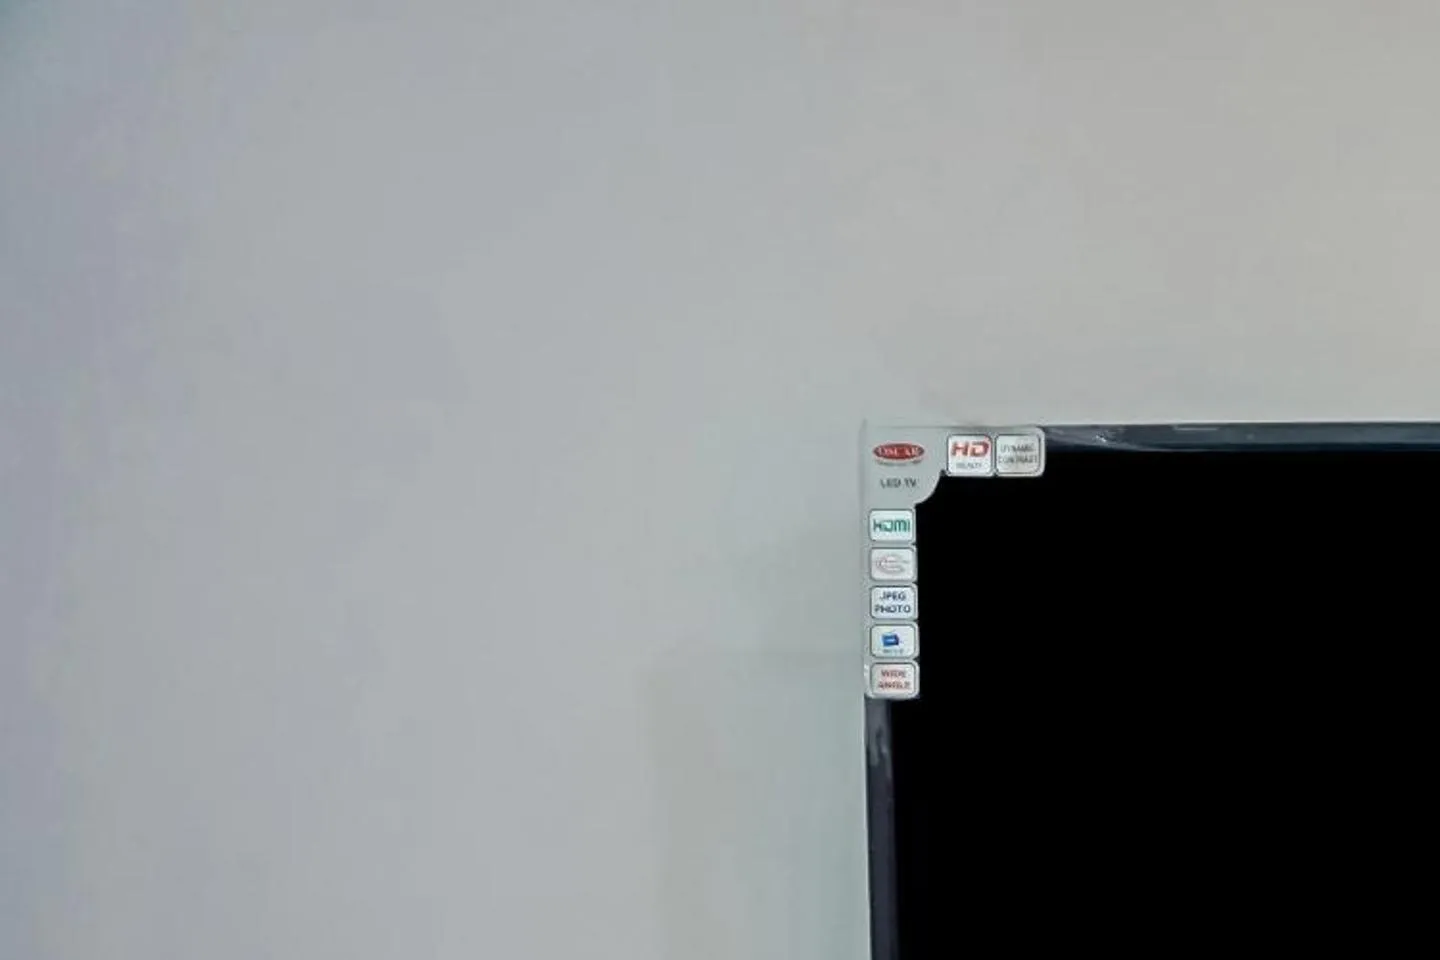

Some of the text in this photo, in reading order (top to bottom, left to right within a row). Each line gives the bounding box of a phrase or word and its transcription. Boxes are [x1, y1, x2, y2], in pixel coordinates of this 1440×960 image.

[951, 441, 990, 457] HD
[880, 591, 906, 601] JPEG
[875, 604, 911, 614] PHOTO
